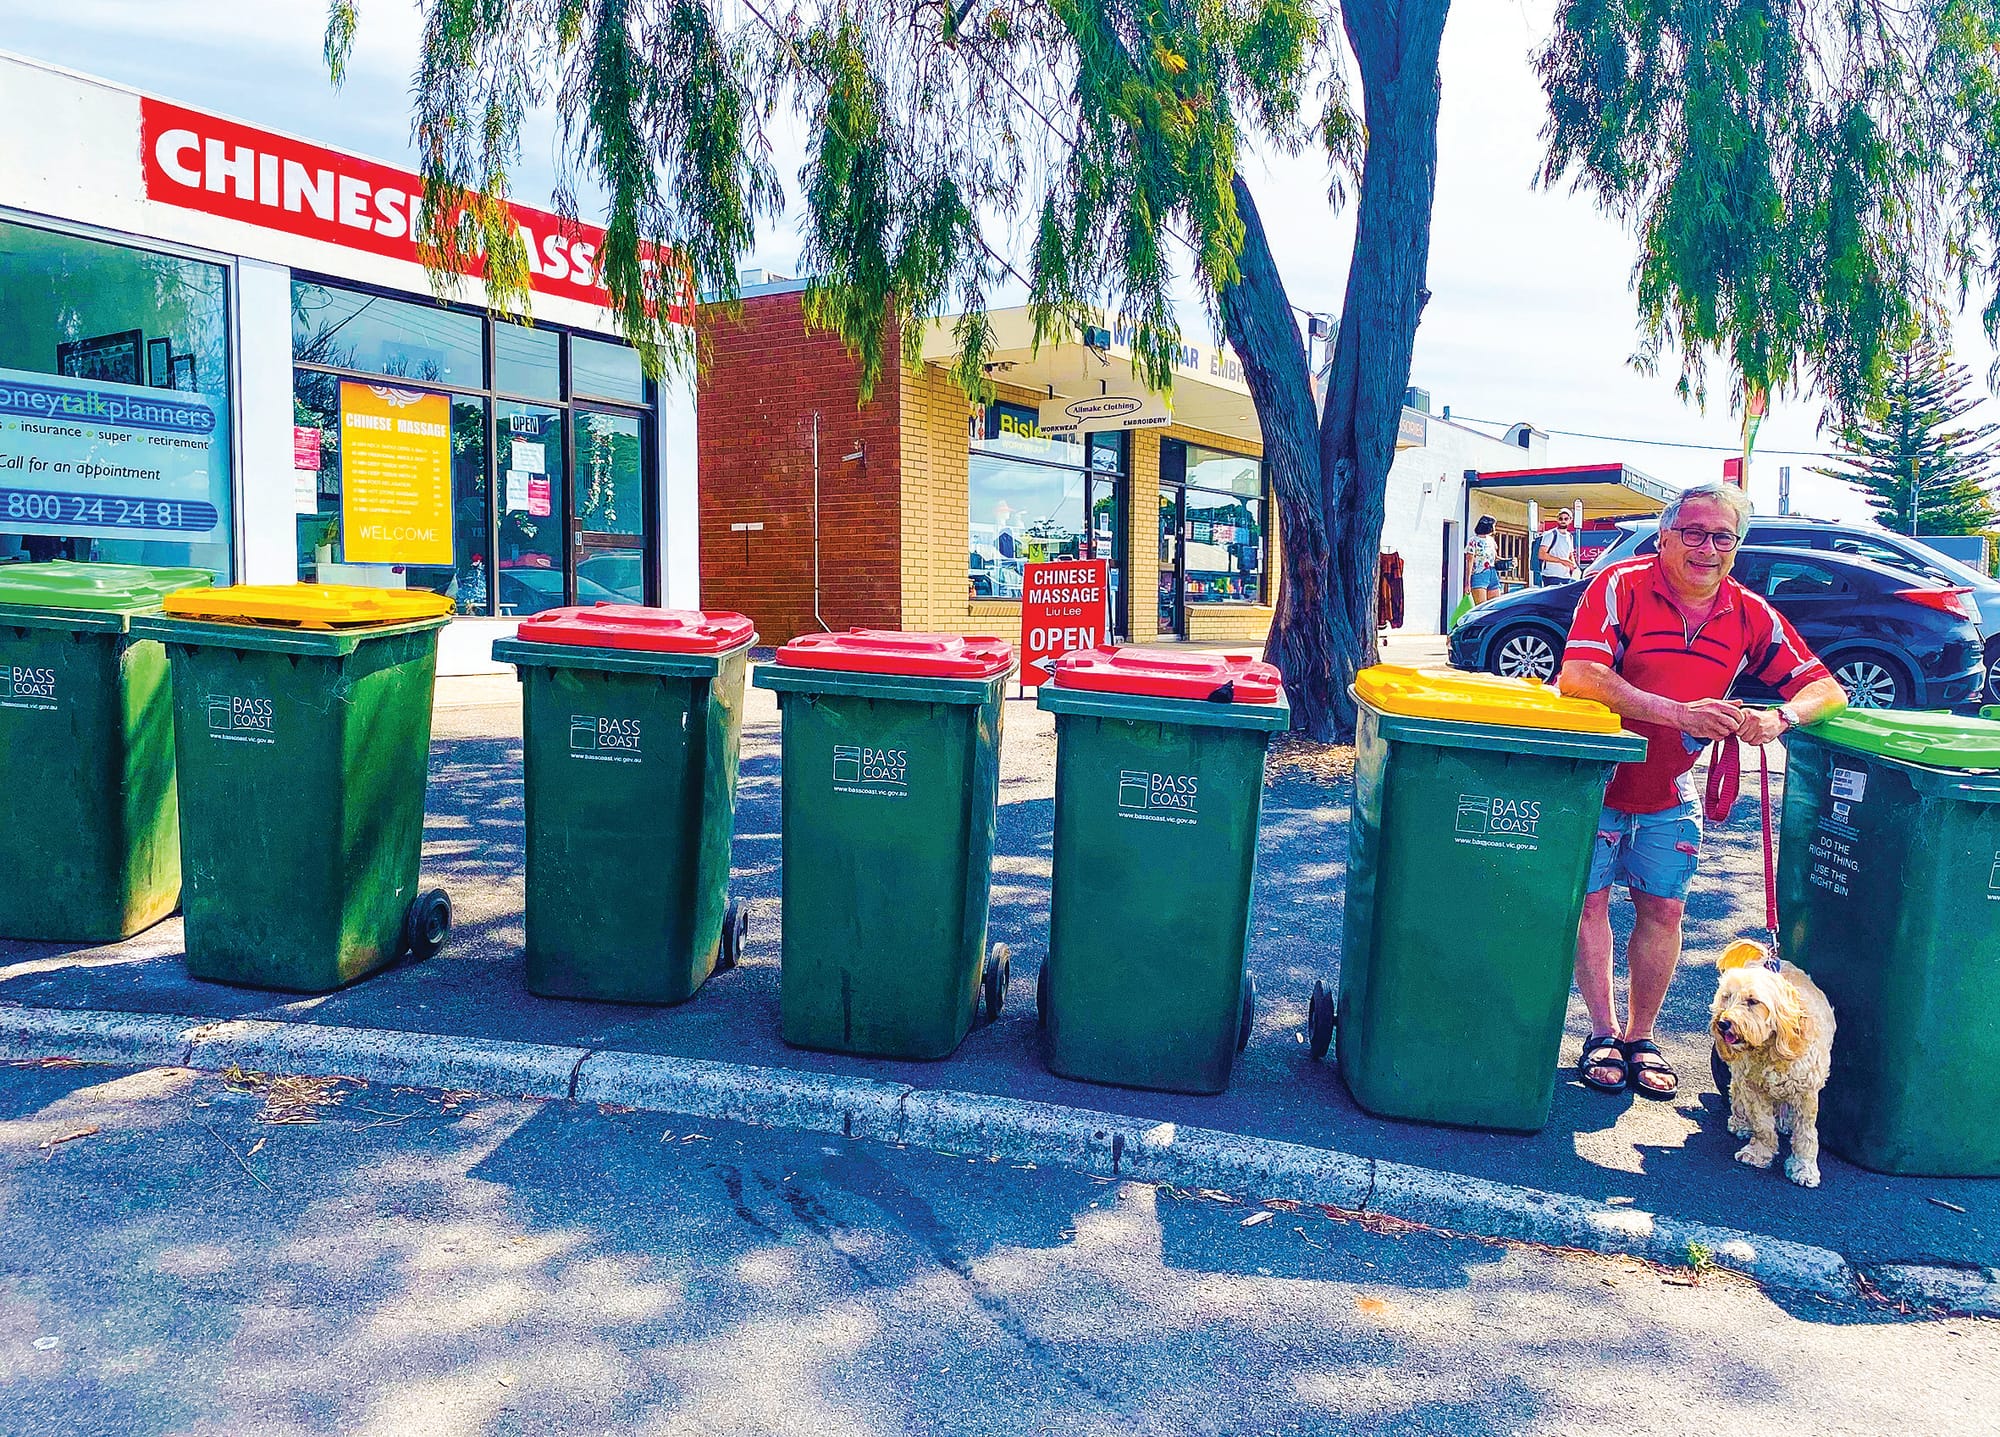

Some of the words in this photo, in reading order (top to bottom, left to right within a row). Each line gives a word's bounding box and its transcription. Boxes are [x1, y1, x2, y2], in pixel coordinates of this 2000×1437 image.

[0, 390, 211, 428] oneytalkplanners
[1103, 403, 1134, 412] Clothing
[345, 412, 393, 431] CHINESE
[397, 419, 447, 438] MASSAGE
[513, 415, 538, 433] OPEN
[1040, 424, 1078, 433] WORKWEAR
[1123, 417, 1166, 426] EMBROIDERY
[20, 421, 82, 437] insurance
[98, 431, 132, 443] super
[148, 435, 209, 450] retirement
[28, 456, 49, 473] for
[53, 462, 71, 473] an
[76, 463, 161, 480] appointment
[71, 496, 105, 522] 24
[114, 499, 148, 525] 24
[157, 502, 183, 526] 81
[359, 525, 440, 542] WELCOME
[1034, 568, 1096, 586] CHINESE
[1029, 588, 1100, 604] MASSAGE
[1045, 607, 1061, 617] Liu
[1063, 606, 1082, 616] Lee
[1029, 627, 1096, 651] OPEN
[13, 666, 55, 684] BASS
[13, 682, 55, 696] COAST
[233, 696, 273, 716] BASS
[233, 714, 273, 728] COAST
[598, 717, 641, 736] BASS
[598, 734, 640, 747] COAST
[863, 747, 907, 767] BASS
[863, 765, 906, 780] COAST
[1151, 773, 1198, 794] BASS
[1150, 792, 1197, 807] COAST
[1492, 798, 1541, 820] BASS
[1490, 817, 1539, 832] COAST
[1808, 843, 1832, 860] RIGHT
[1820, 836, 1833, 849] DO
[1833, 840, 1851, 855] THE
[1814, 862, 1830, 877] USE
[1831, 869, 1848, 884] THE
[1809, 873, 1833, 890] RIGHT
[1833, 883, 1849, 897] BIN
